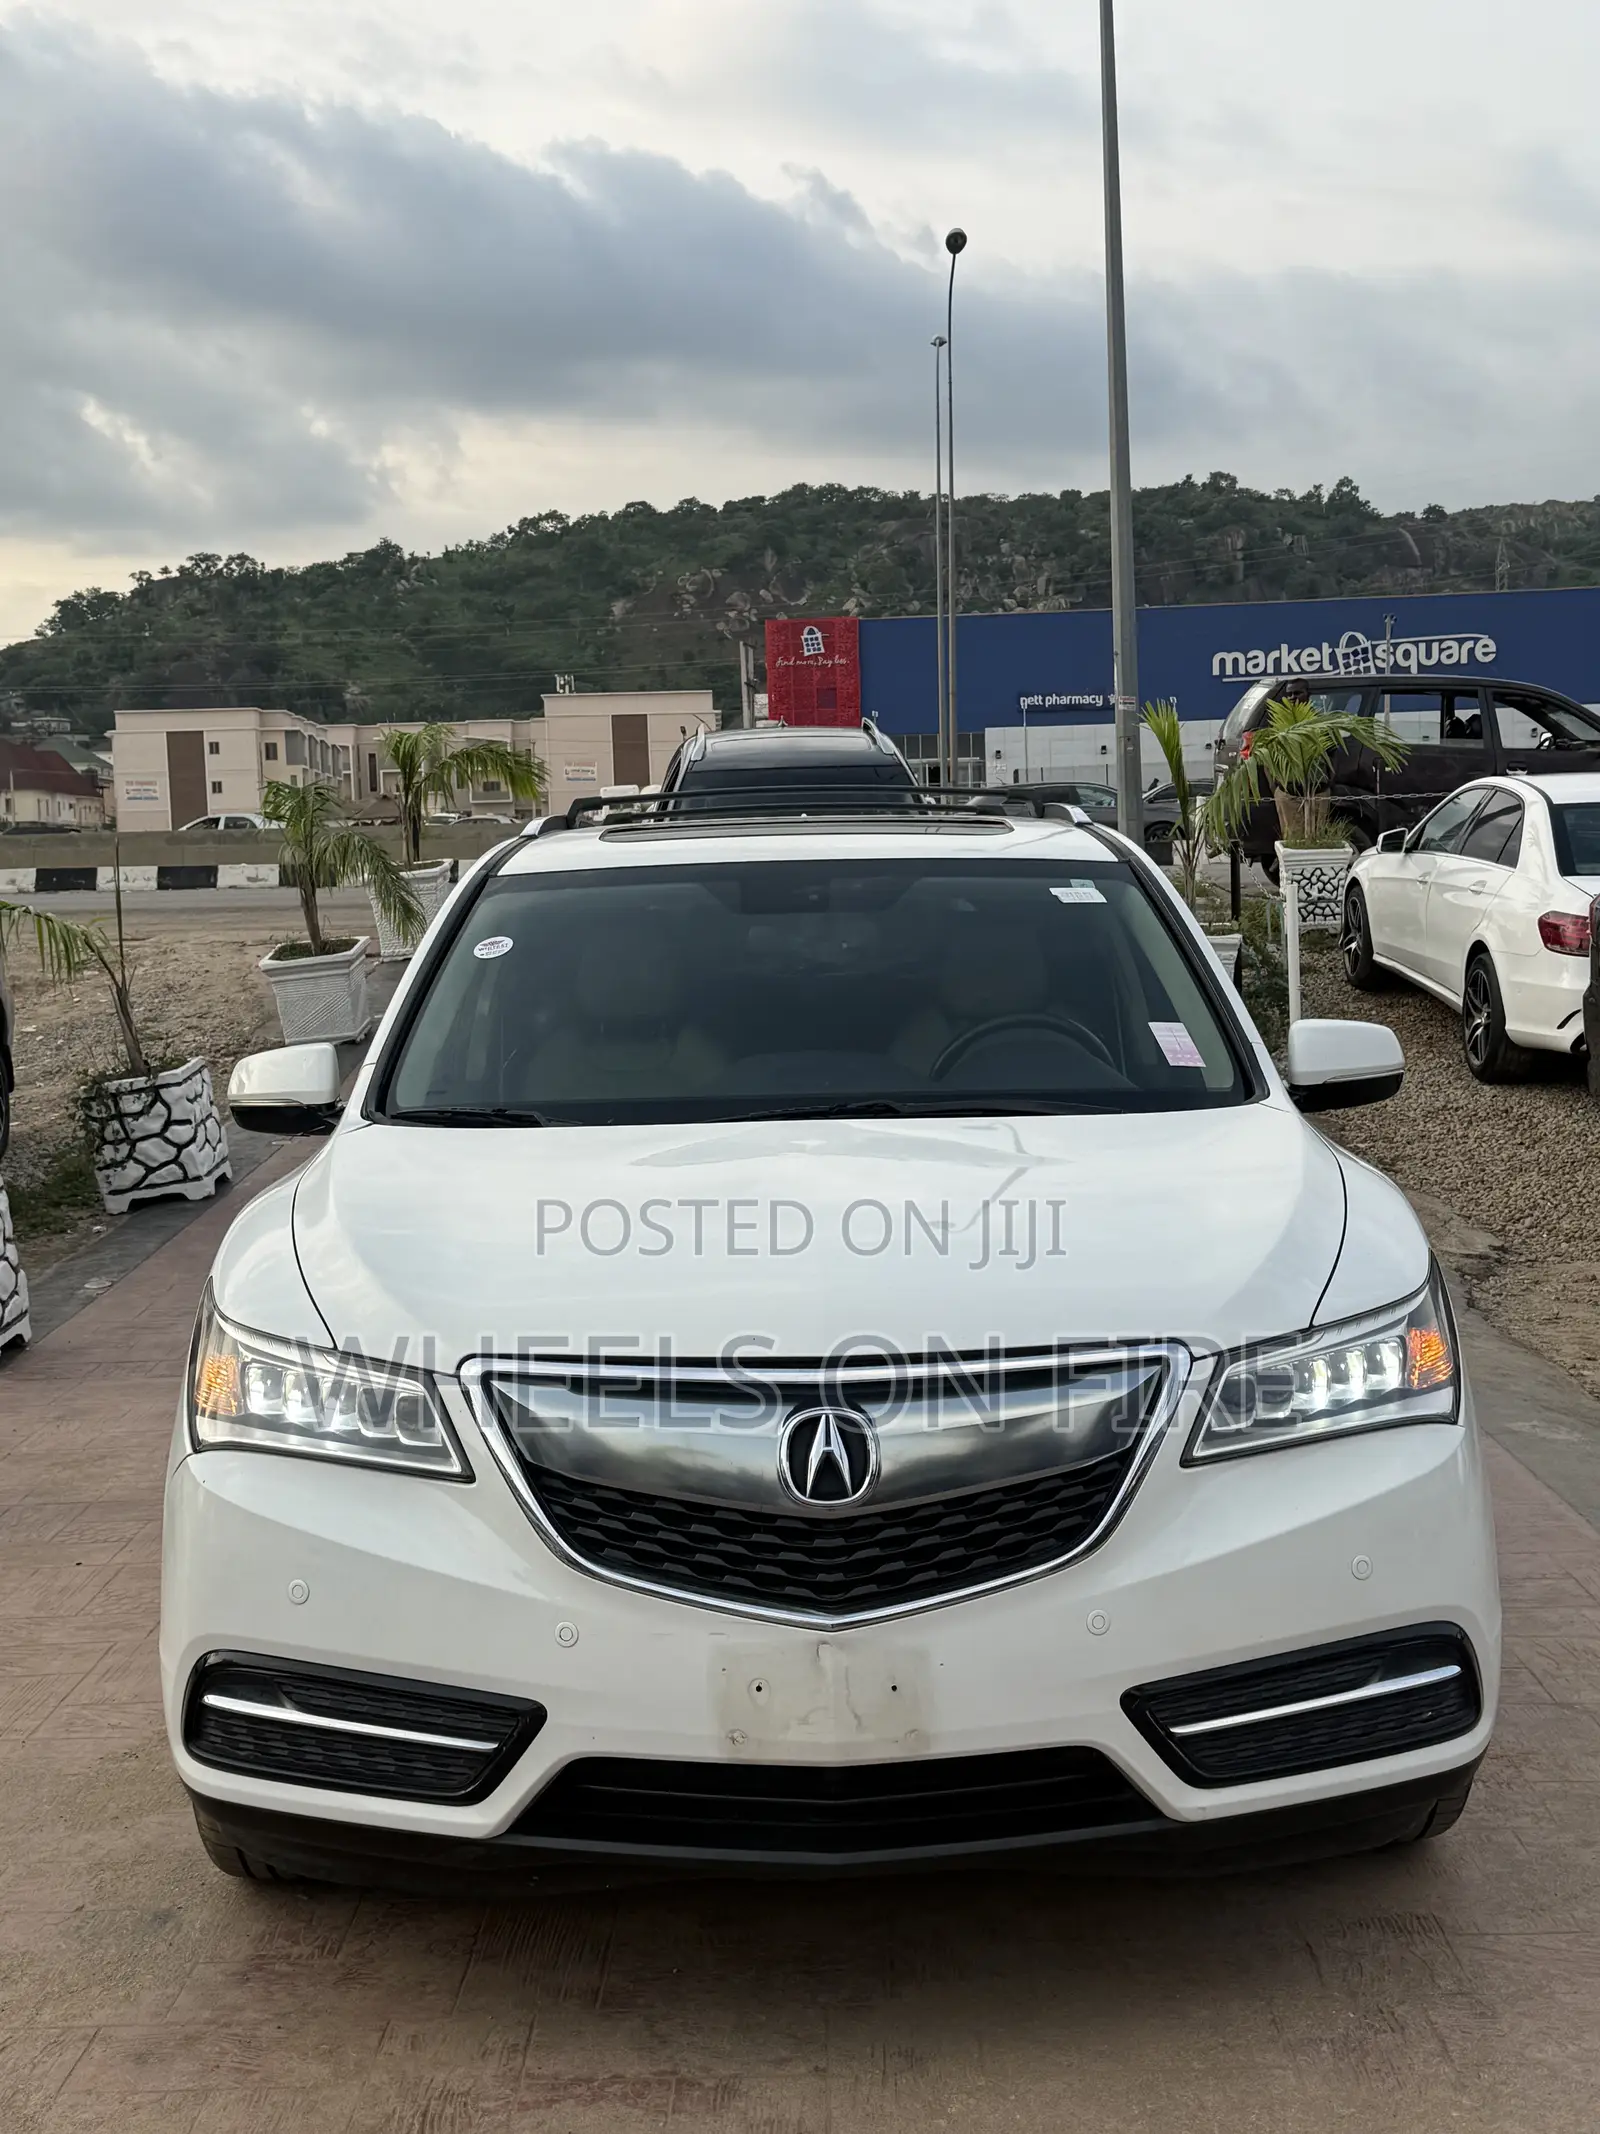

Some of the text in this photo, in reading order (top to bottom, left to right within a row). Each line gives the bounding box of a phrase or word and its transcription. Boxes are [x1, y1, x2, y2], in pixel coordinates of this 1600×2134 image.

[1212, 638, 1497, 676] market square
[1045, 694, 1103, 707] pharmacy
